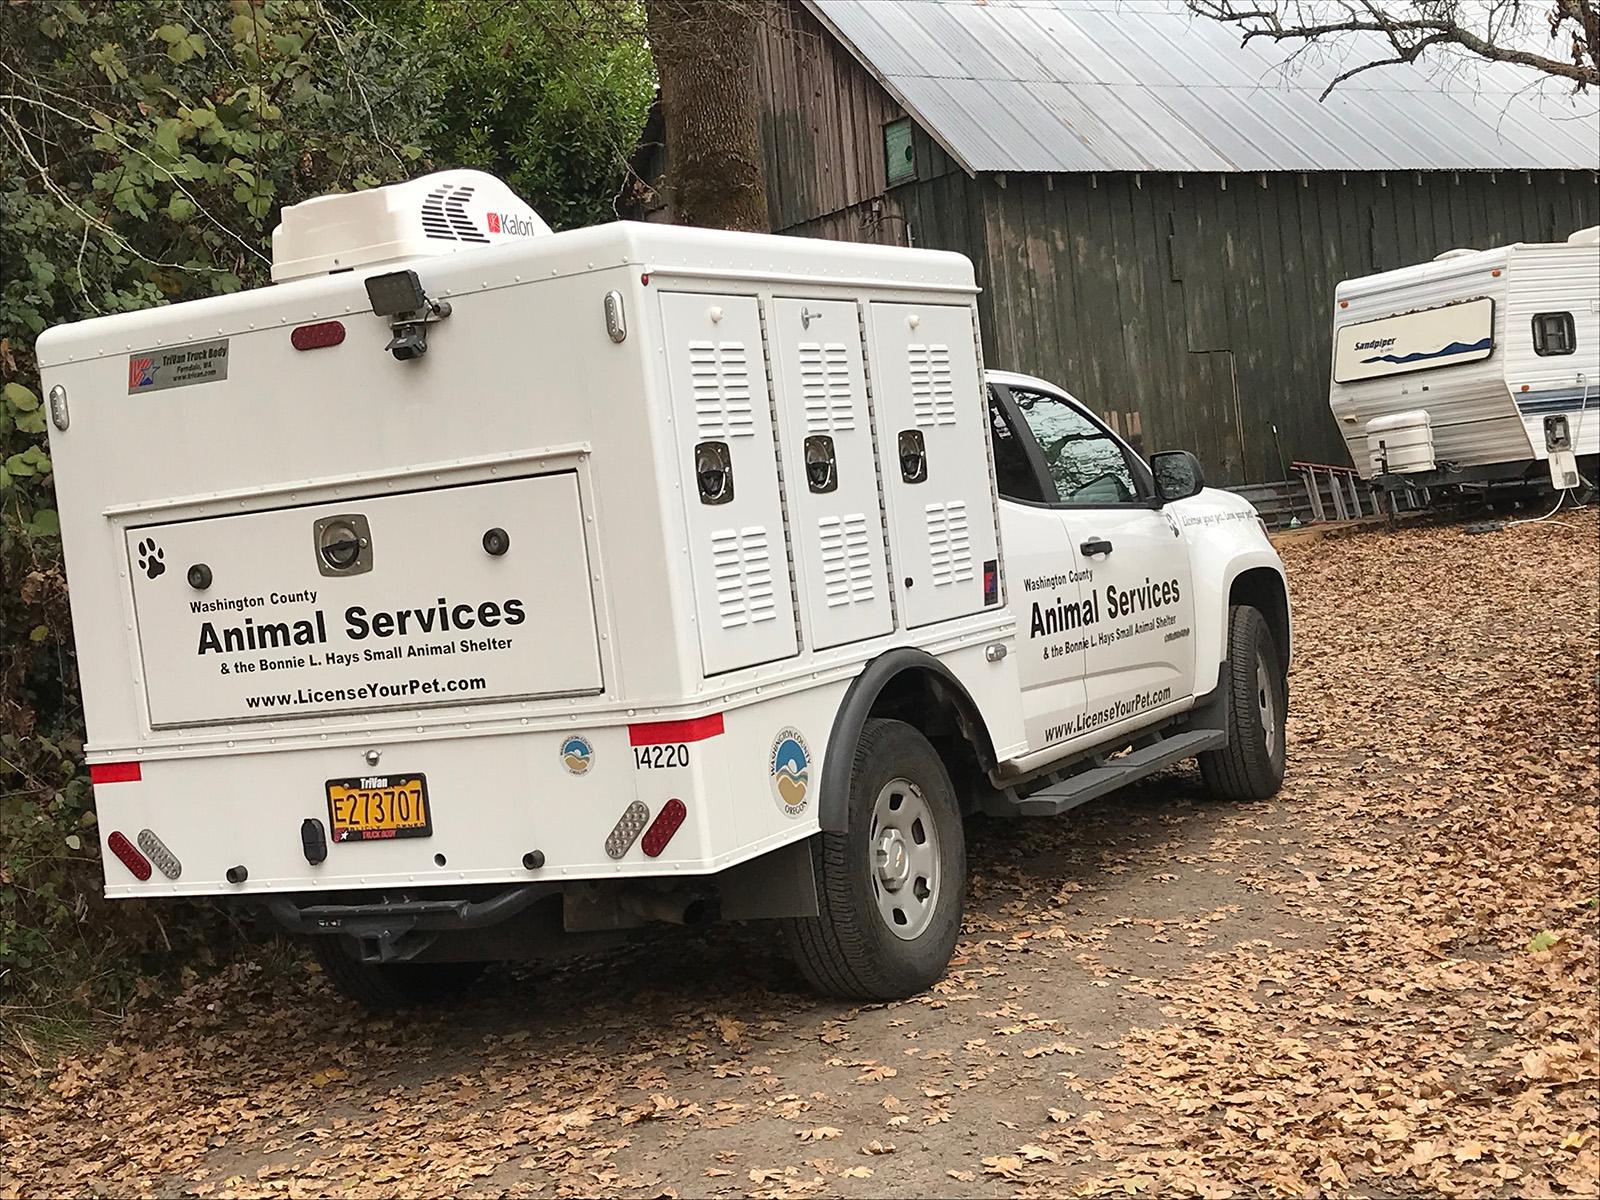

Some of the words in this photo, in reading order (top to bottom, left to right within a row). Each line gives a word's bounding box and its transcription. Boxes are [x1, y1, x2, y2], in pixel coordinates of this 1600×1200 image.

[500, 213, 534, 236] Kalori
[187, 350, 207, 362] Truck
[208, 347, 227, 359] Body
[1354, 338, 1397, 351] Sandpiper
[1024, 573, 1067, 592] Washington
[1069, 568, 1093, 583] County
[190, 595, 265, 613] Washington
[270, 589, 318, 603] County
[1030, 589, 1099, 639] Animal
[1106, 577, 1180, 619] Services
[198, 610, 327, 655] Animal
[345, 597, 526, 640] Services
[1043, 647, 1050, 660] &
[1051, 645, 1064, 658] the
[1065, 637, 1089, 654] Bonnie
[1090, 635, 1097, 647] L.
[1098, 632, 1115, 646] Hays
[1116, 624, 1134, 640] Small
[1135, 620, 1155, 635] Animal
[1156, 614, 1177, 629] Shelter
[220, 662, 230, 675] &
[234, 661, 256, 673] the
[259, 656, 305, 671] Bonnie
[309, 654, 322, 666] L.
[326, 652, 360, 666] Hays
[363, 646, 402, 661] Small
[407, 641, 456, 658] Animal
[460, 638, 512, 653] Shelter
[246, 677, 486, 708] www.LicenseYourPet.com
[1045, 686, 1171, 742] www.LicenseYourPet.com
[633, 744, 690, 770] 14220
[793, 731, 812, 764] COUNTY
[360, 777, 388, 789] TriVan
[333, 790, 421, 825] E273707
[784, 800, 808, 815] OREGON
